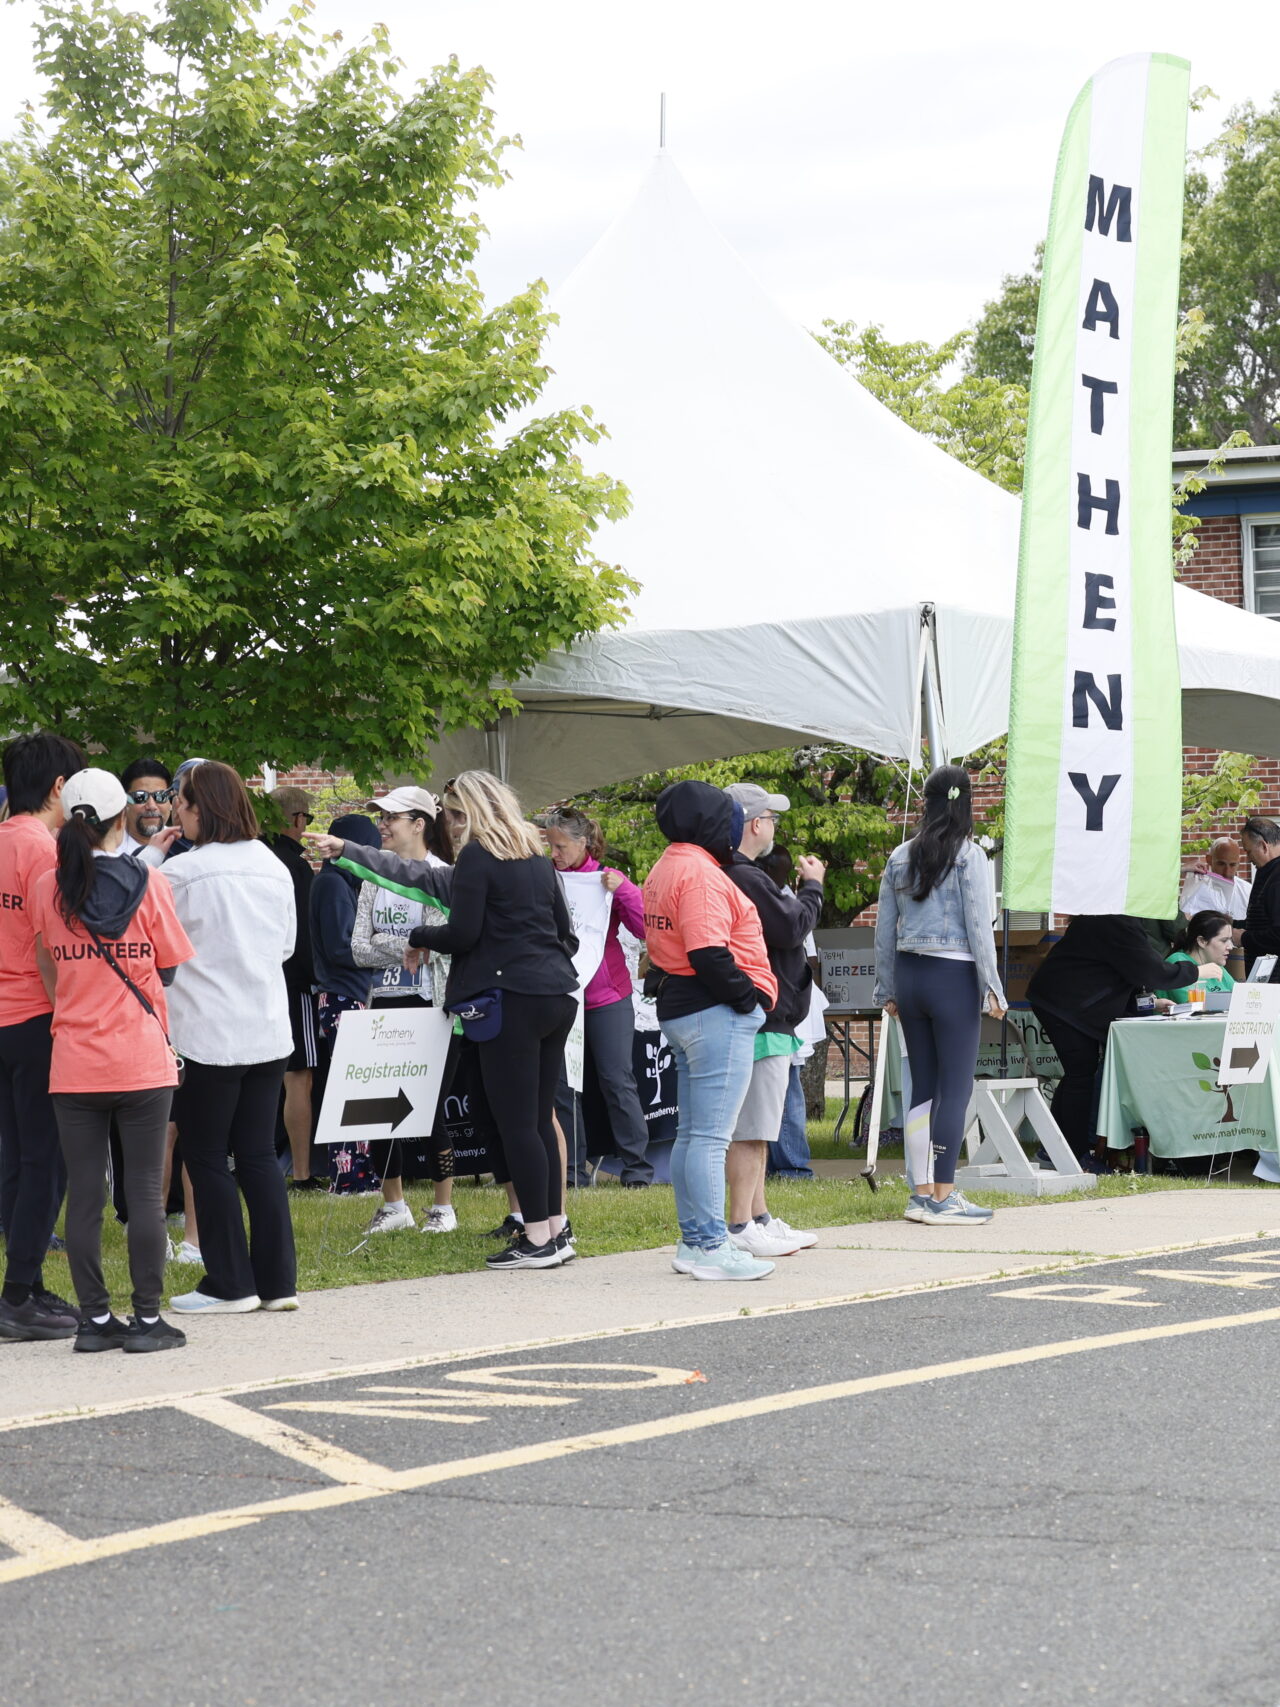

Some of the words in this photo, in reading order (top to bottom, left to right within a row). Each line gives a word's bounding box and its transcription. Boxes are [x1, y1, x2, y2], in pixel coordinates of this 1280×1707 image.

[1071, 174, 1133, 832] MATHENY
[828, 965, 875, 976] JERZEE
[1229, 1023, 1274, 1034] REGISTRATION
[345, 1060, 428, 1084] Registration
[262, 1362, 696, 1425] NO
